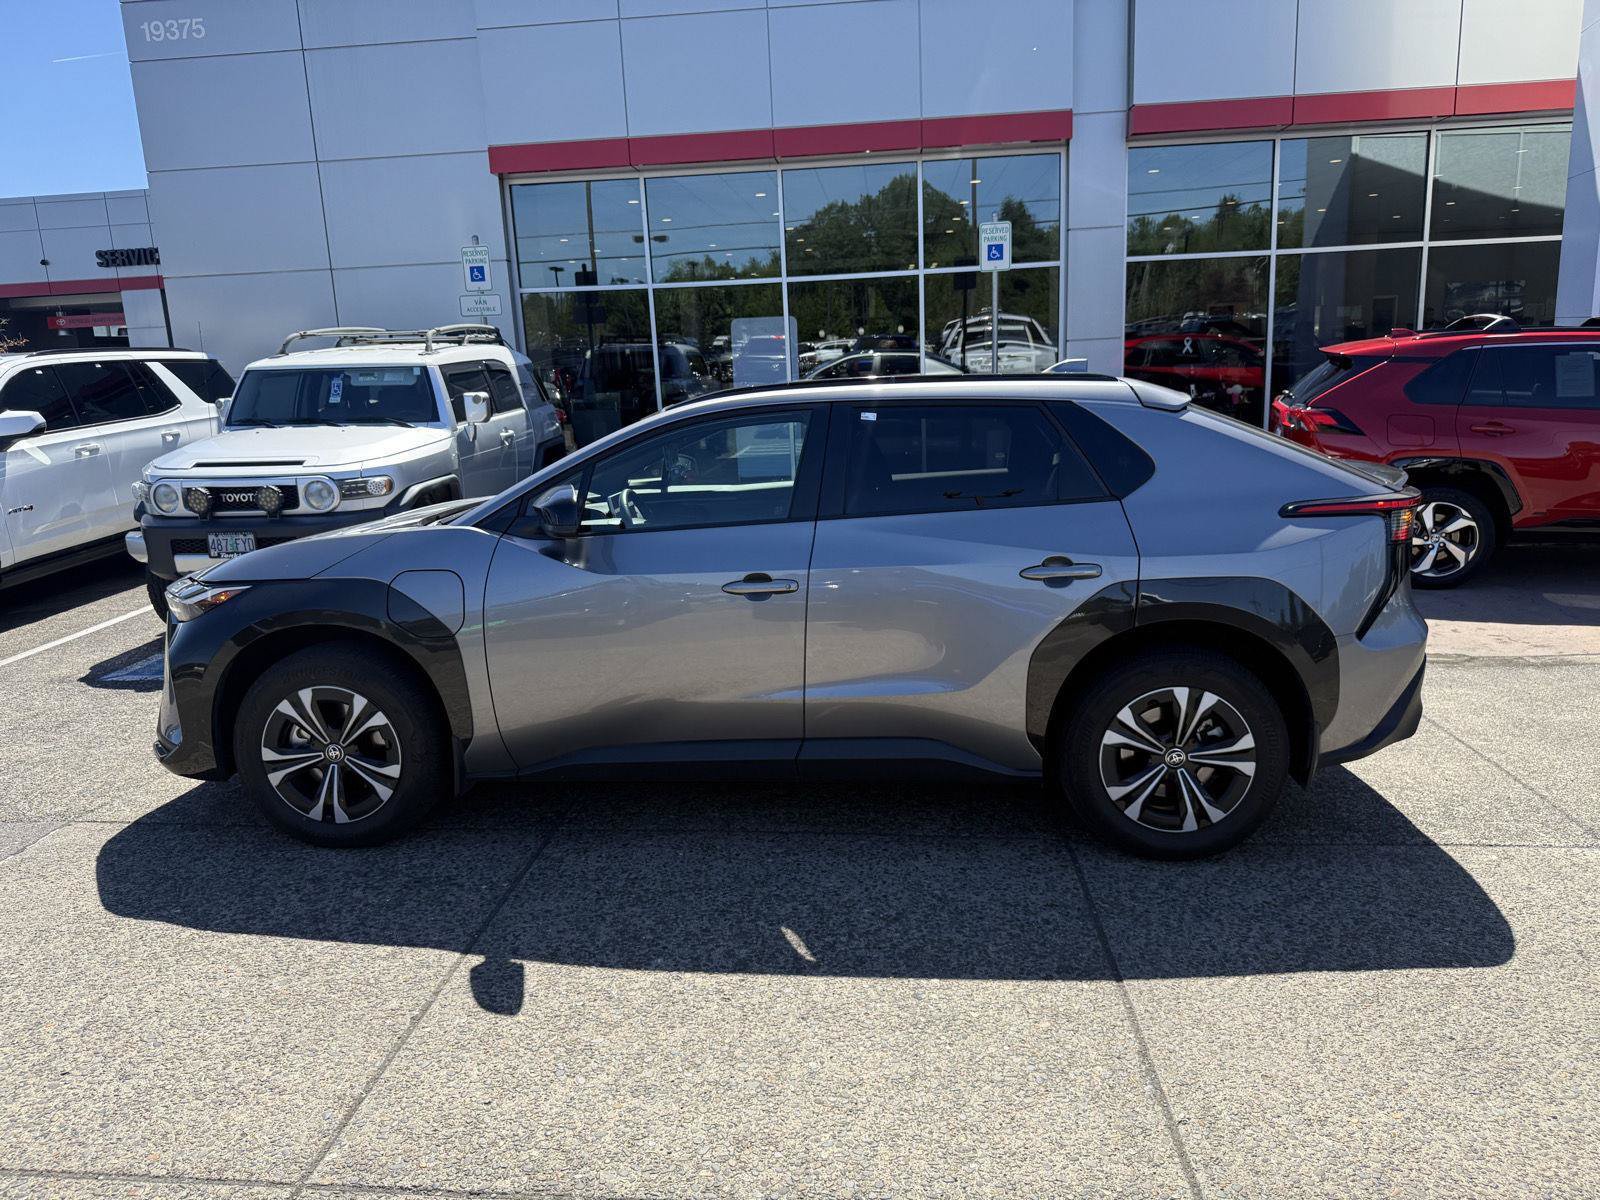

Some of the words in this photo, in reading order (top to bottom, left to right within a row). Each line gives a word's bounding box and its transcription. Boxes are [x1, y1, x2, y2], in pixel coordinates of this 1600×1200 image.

[140, 18, 206, 42] 19375
[982, 226, 1009, 235] RESERVED
[95, 247, 160, 267] SERVIC
